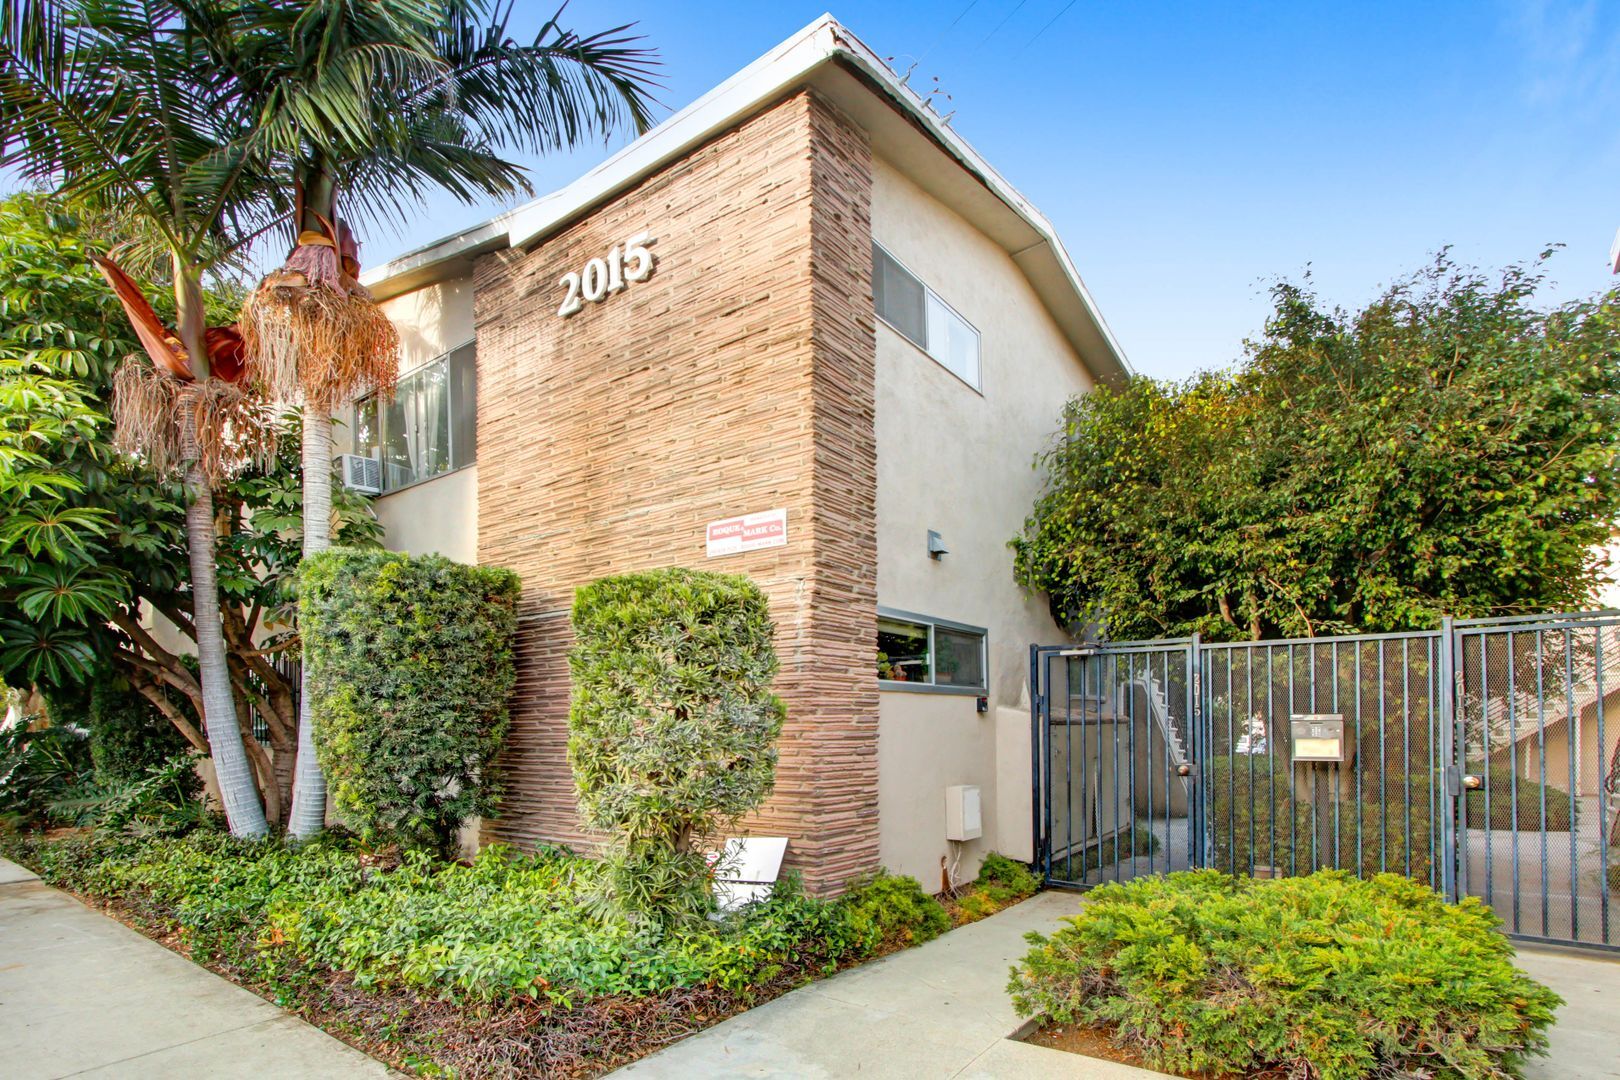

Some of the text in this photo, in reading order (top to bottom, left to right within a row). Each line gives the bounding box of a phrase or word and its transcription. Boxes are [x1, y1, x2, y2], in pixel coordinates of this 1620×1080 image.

[557, 230, 658, 317] 2015
[743, 525, 767, 536] MARK
[1193, 673, 1201, 716] 2015
